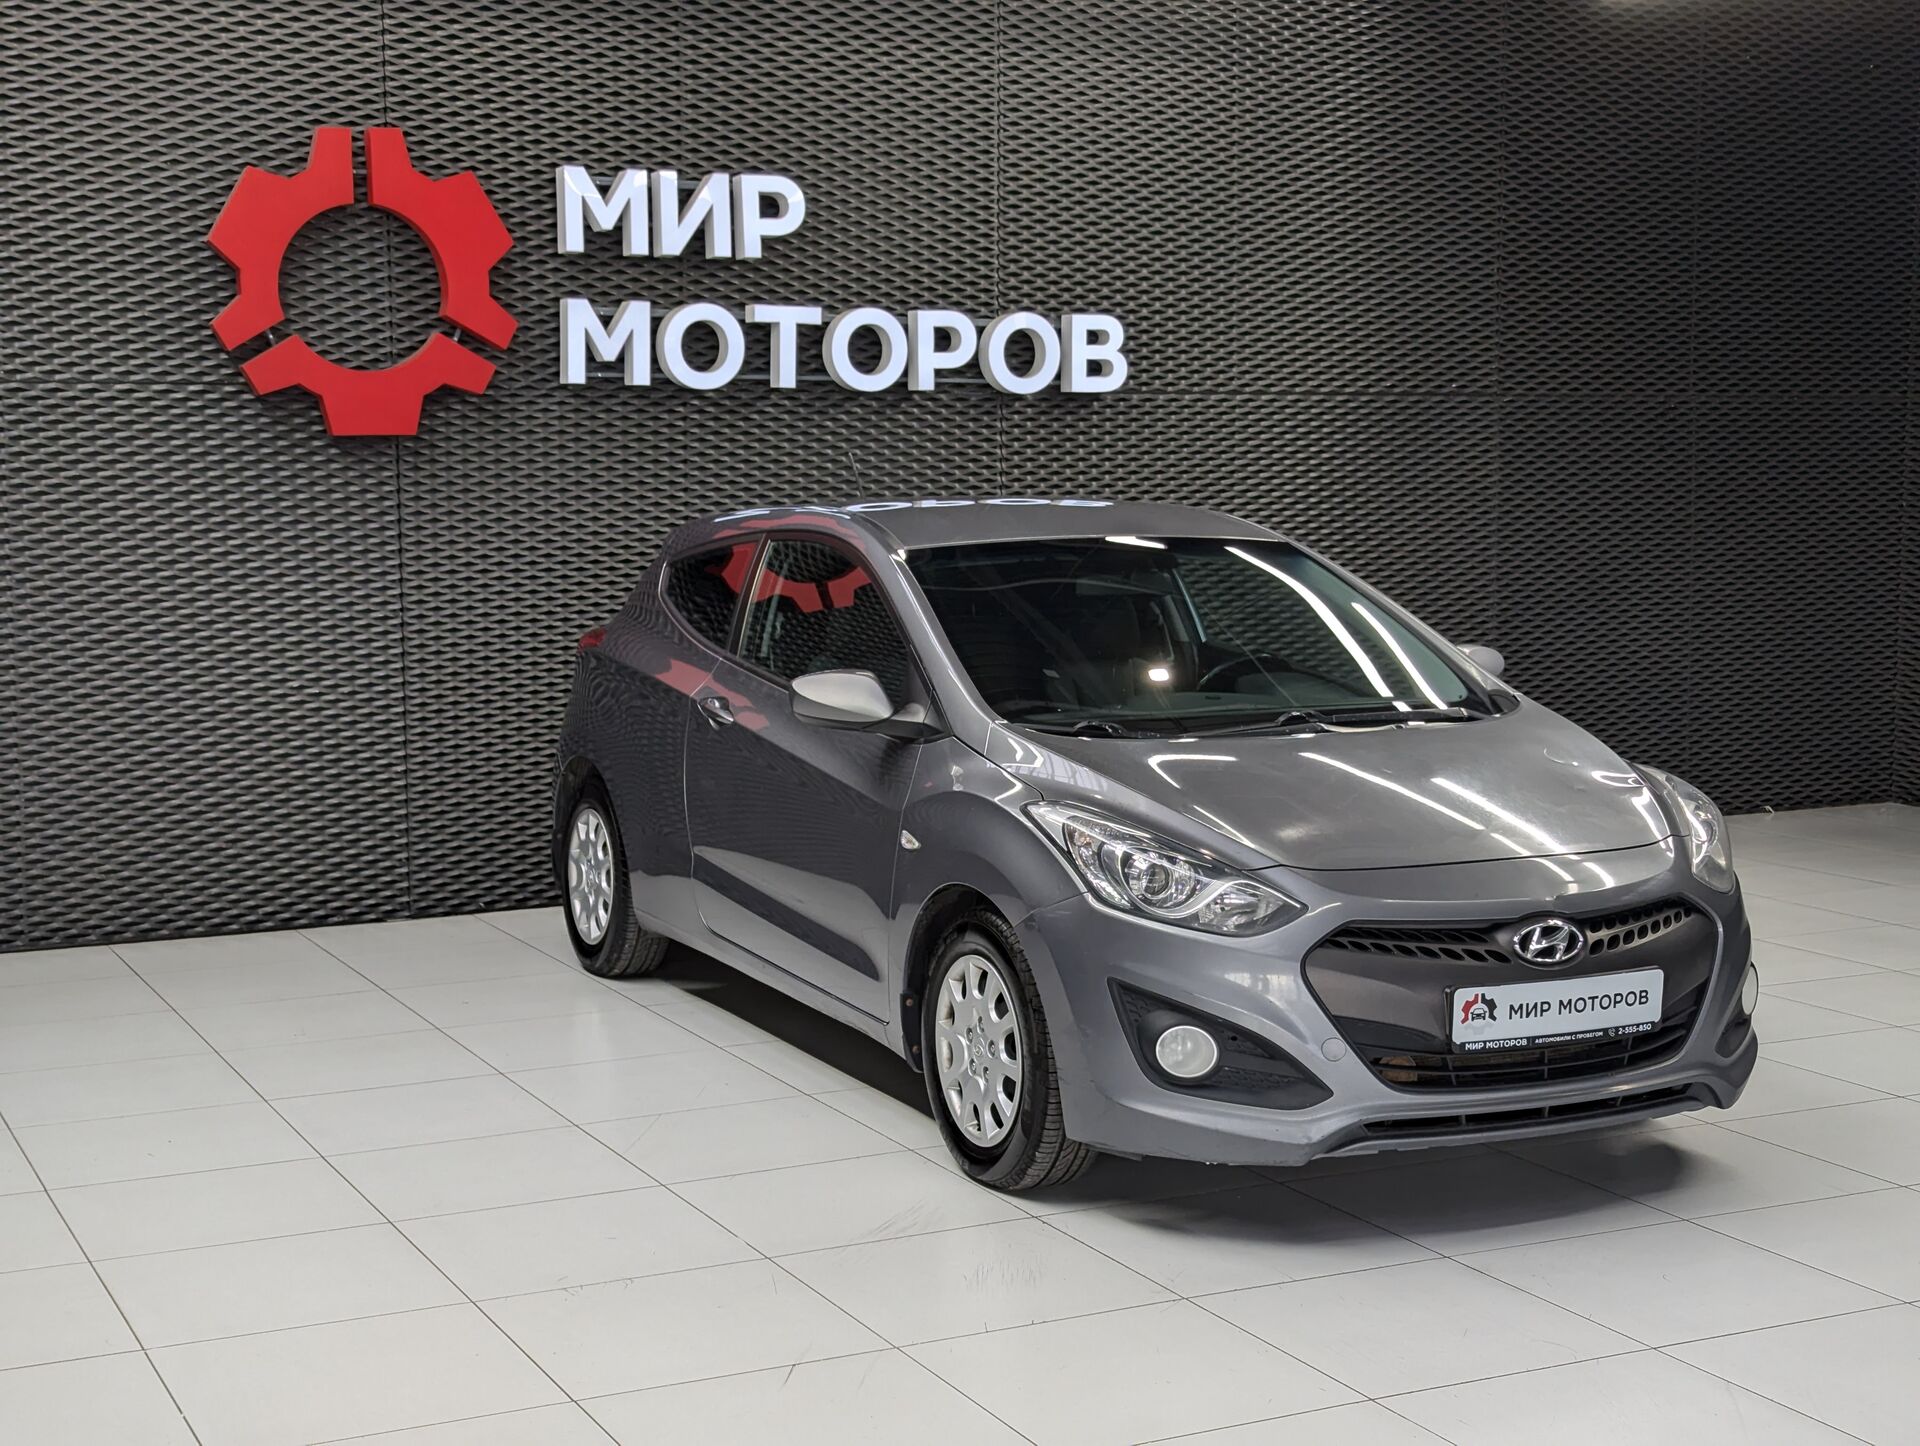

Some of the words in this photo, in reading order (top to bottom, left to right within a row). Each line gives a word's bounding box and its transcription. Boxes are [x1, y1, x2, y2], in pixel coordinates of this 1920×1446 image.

[555, 165, 806, 260] МИР
[559, 298, 1128, 395] МОТОРОВ
[1508, 1000, 1551, 1020] МИР
[1558, 989, 1649, 1015] МОТОРОВ
[1465, 1042, 1484, 1050] МИР
[1486, 1038, 1527, 1049] МОТОРОВ
[1535, 1035, 1572, 1044] АВТОМОБИЛИ
[1577, 1031, 1603, 1039] ПРОБЕГОМ
[1618, 1023, 1652, 1035] 2-555-850
